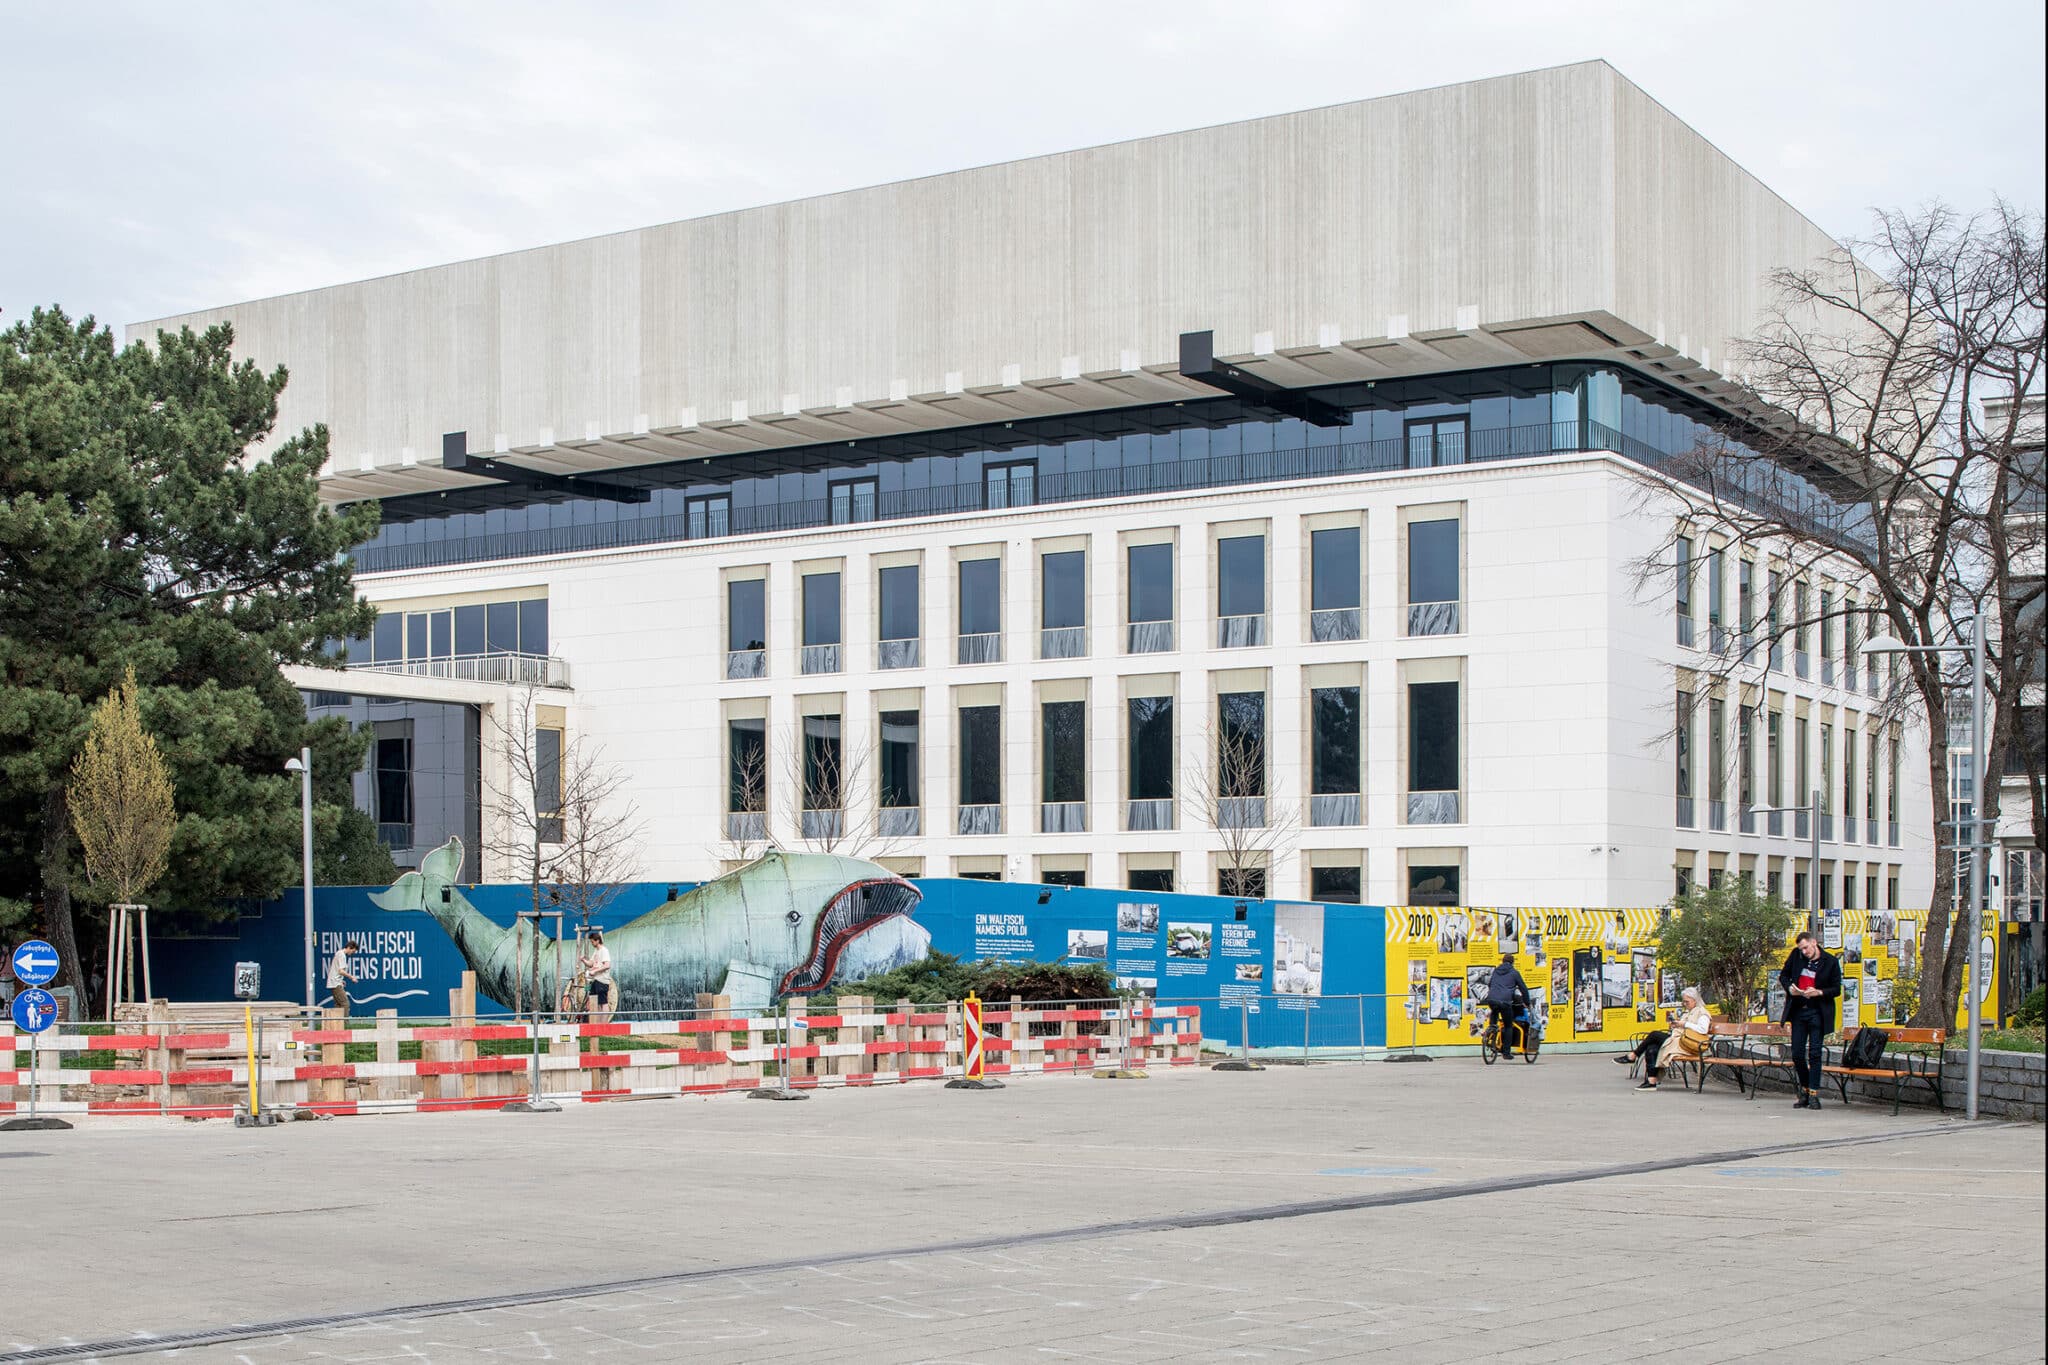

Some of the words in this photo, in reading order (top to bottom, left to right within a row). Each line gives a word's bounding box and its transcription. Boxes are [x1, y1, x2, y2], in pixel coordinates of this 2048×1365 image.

[976, 914, 987, 925] EIN
[989, 914, 1024, 926] WALFISCH
[1408, 914, 1433, 937] 2019
[1546, 914, 1569, 936] 2020
[976, 925, 1005, 936] NAMENS
[1006, 926, 1028, 937] POLDI
[1221, 930, 1243, 938] VEREIN
[1244, 930, 1257, 939] DER
[322, 931, 342, 954] EIN
[346, 931, 415, 954] WALFISCH
[1221, 938, 1249, 948] FREUNDE
[322, 957, 378, 980] NMENS
[382, 957, 422, 980] POLDI
